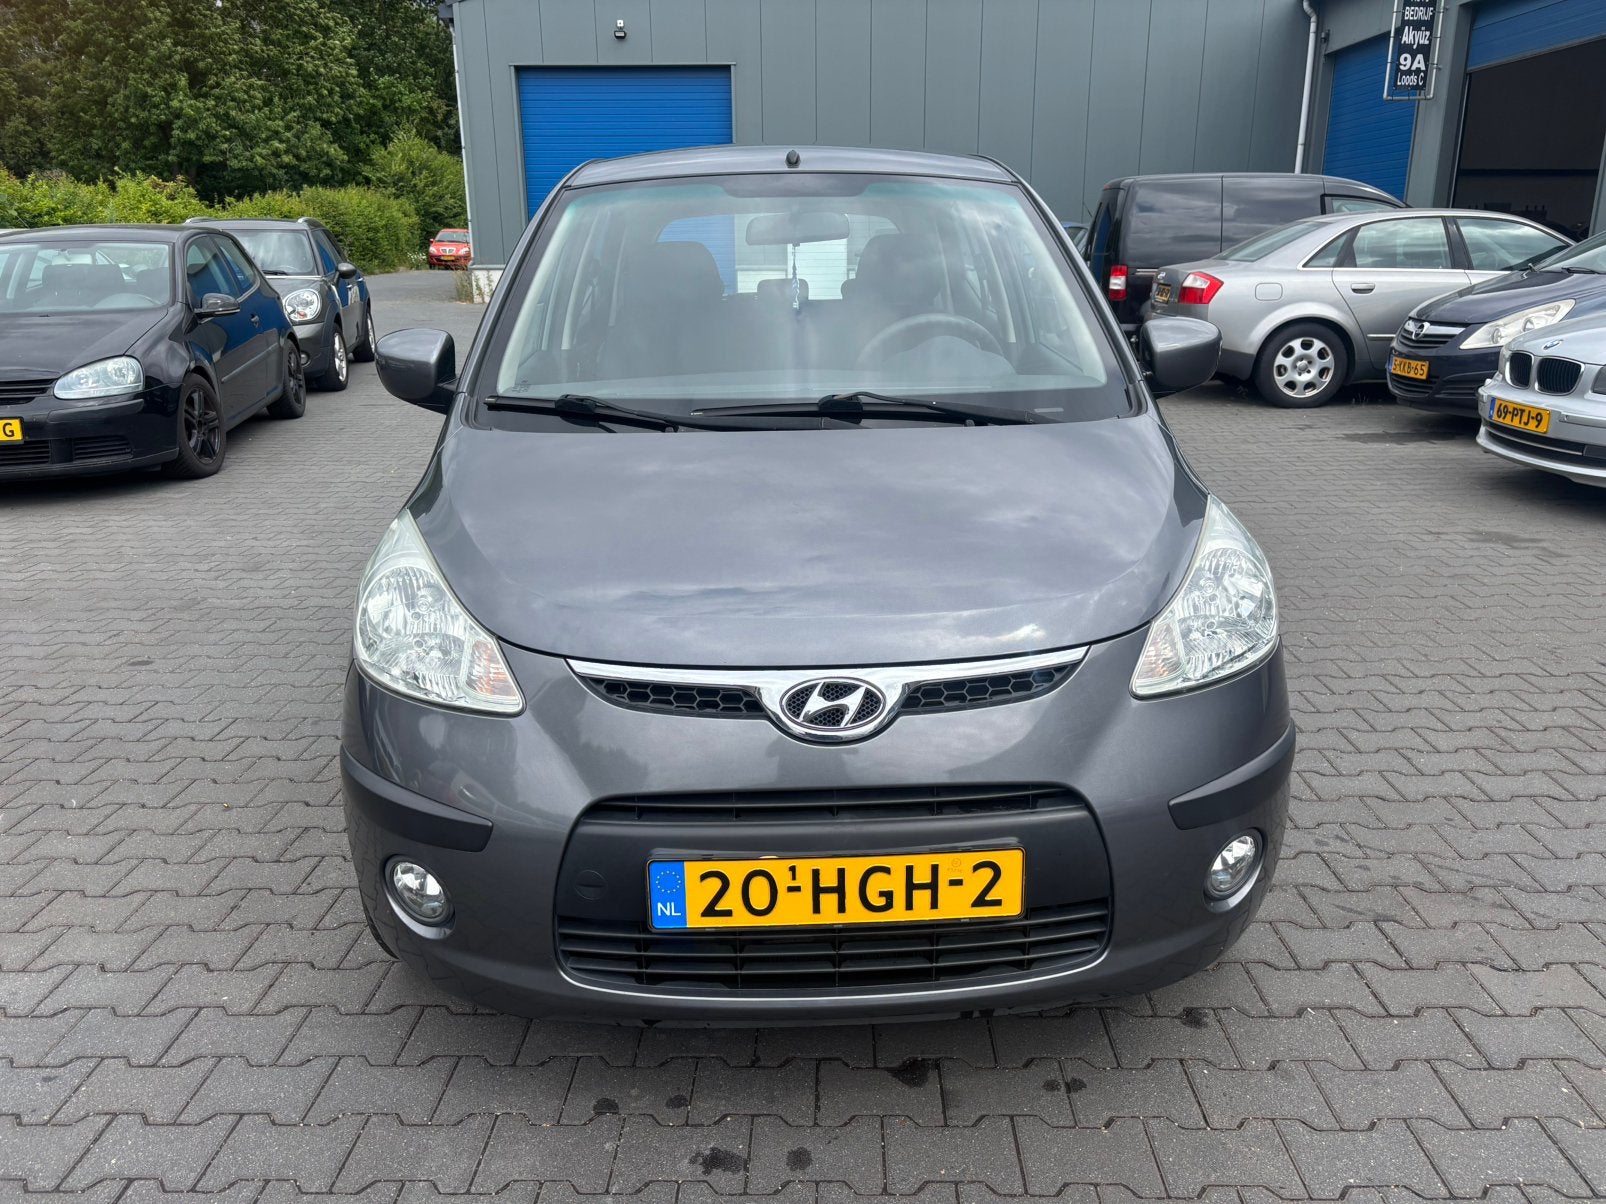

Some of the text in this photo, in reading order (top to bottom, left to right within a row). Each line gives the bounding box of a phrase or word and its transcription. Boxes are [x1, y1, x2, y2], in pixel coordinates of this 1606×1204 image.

[1404, 6, 1434, 20] BEDRIJF
[1401, 25, 1430, 49] Akyüz
[1399, 53, 1426, 71] 9A
[1397, 72, 1424, 86] Loods C
[1496, 403, 1543, 428] 69-PTJ-9
[657, 902, 681, 916] NL
